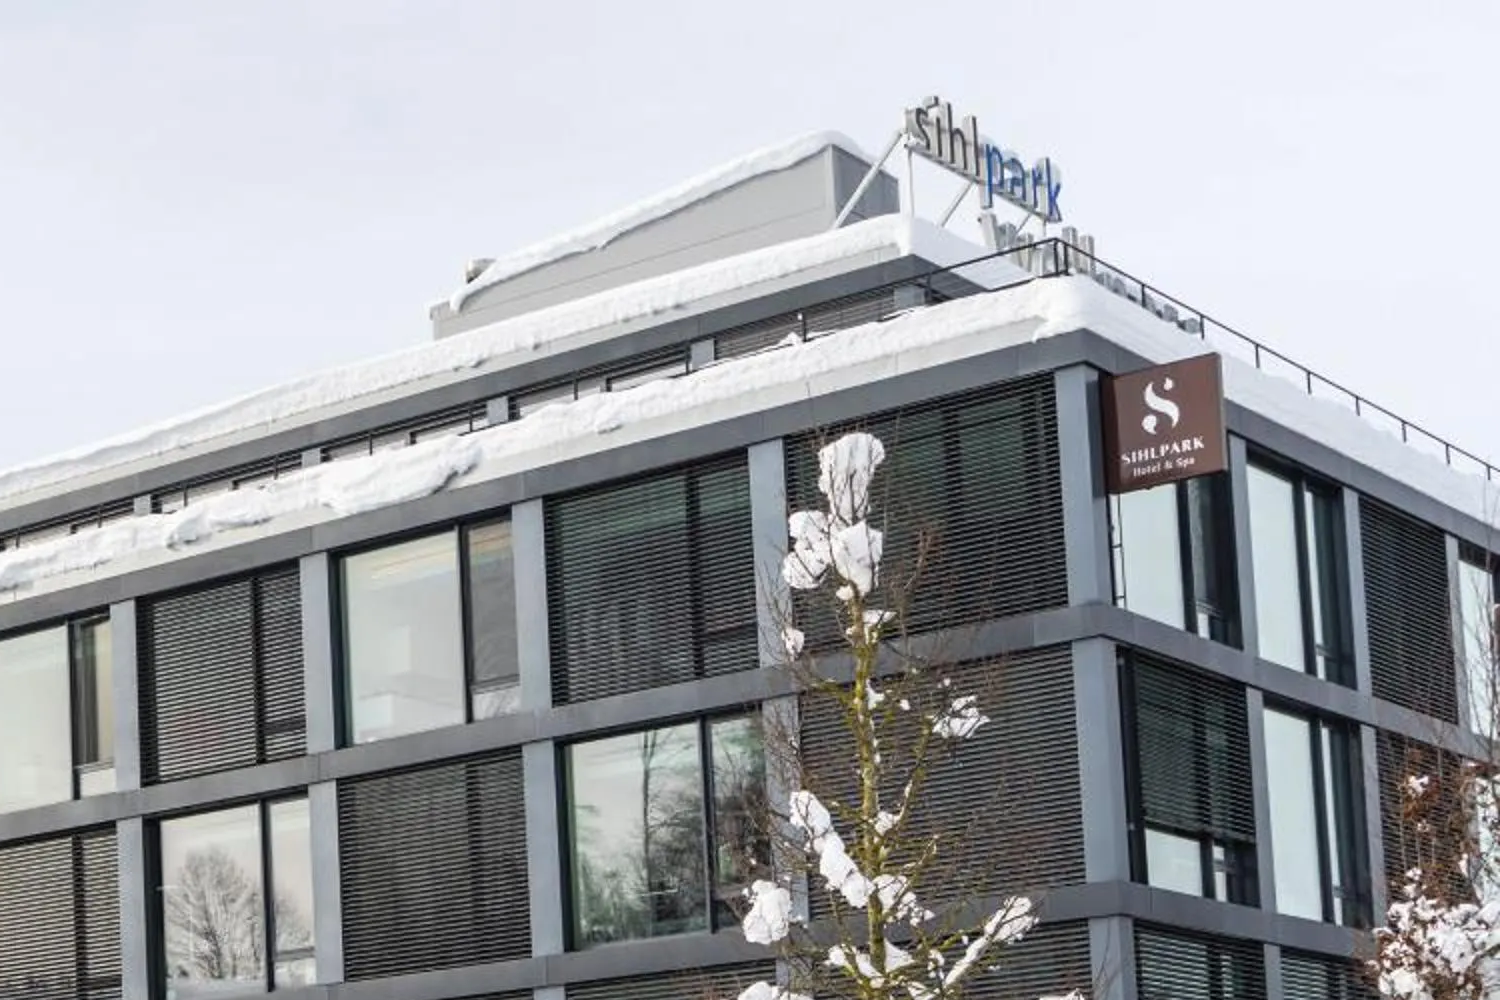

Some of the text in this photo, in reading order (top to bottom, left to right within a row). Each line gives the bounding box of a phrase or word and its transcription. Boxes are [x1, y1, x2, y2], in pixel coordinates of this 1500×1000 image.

[1121, 436, 1205, 465] SIHLPARK
[1133, 462, 1161, 477] Hotel
[1176, 456, 1196, 469] Spa
